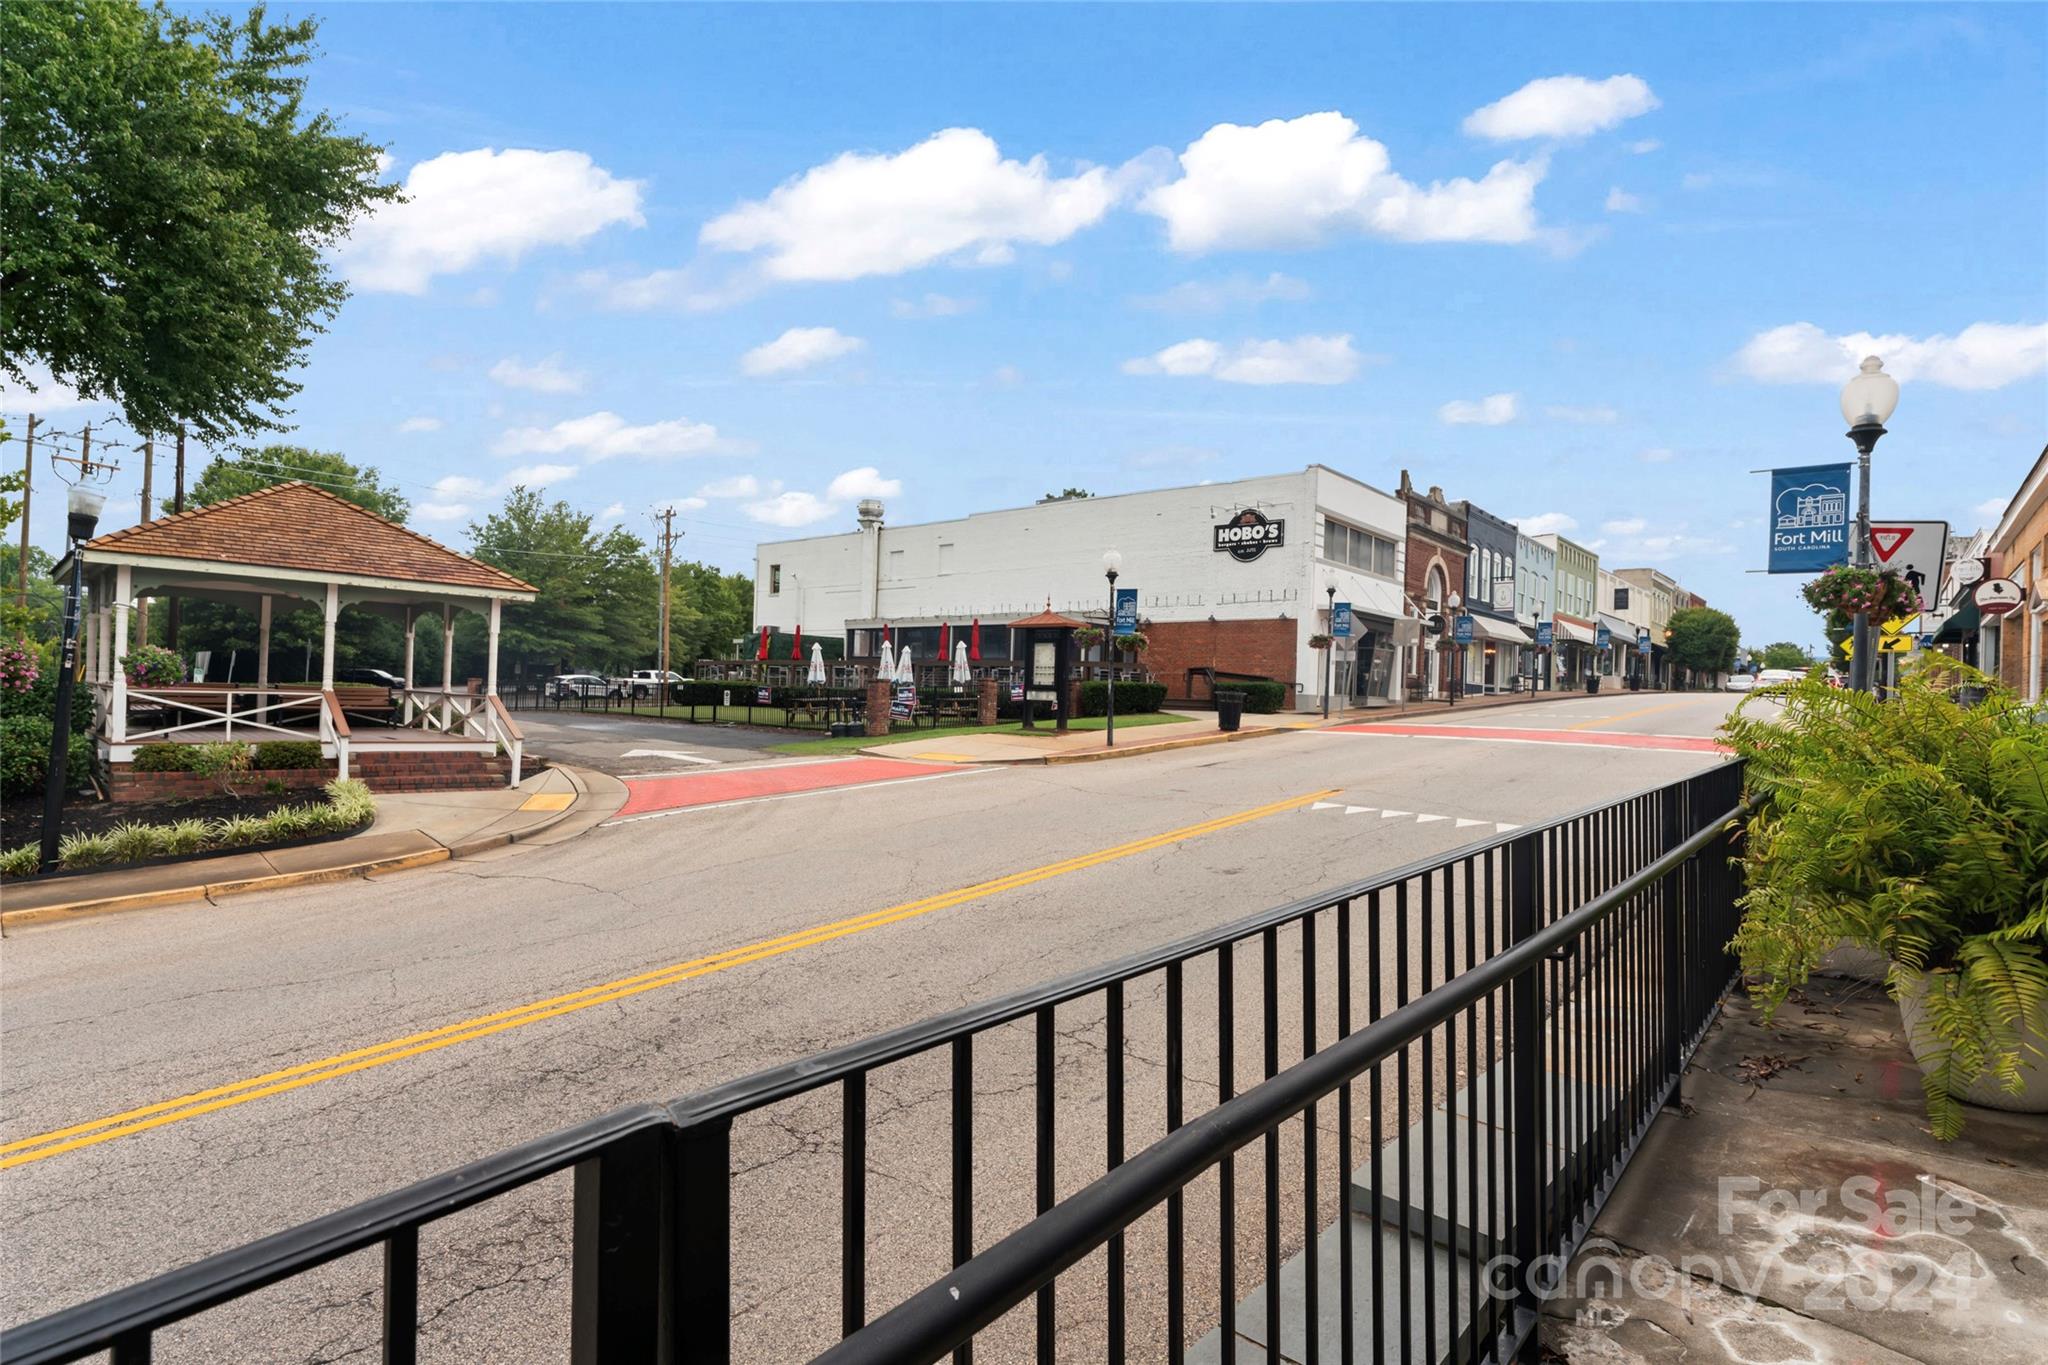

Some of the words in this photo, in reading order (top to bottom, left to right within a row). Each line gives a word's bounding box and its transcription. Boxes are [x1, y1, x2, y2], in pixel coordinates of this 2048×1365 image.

[1218, 523, 1279, 543] HOBO'S
[1774, 532, 1806, 545] Fort
[1810, 529, 1843, 544] Mill
